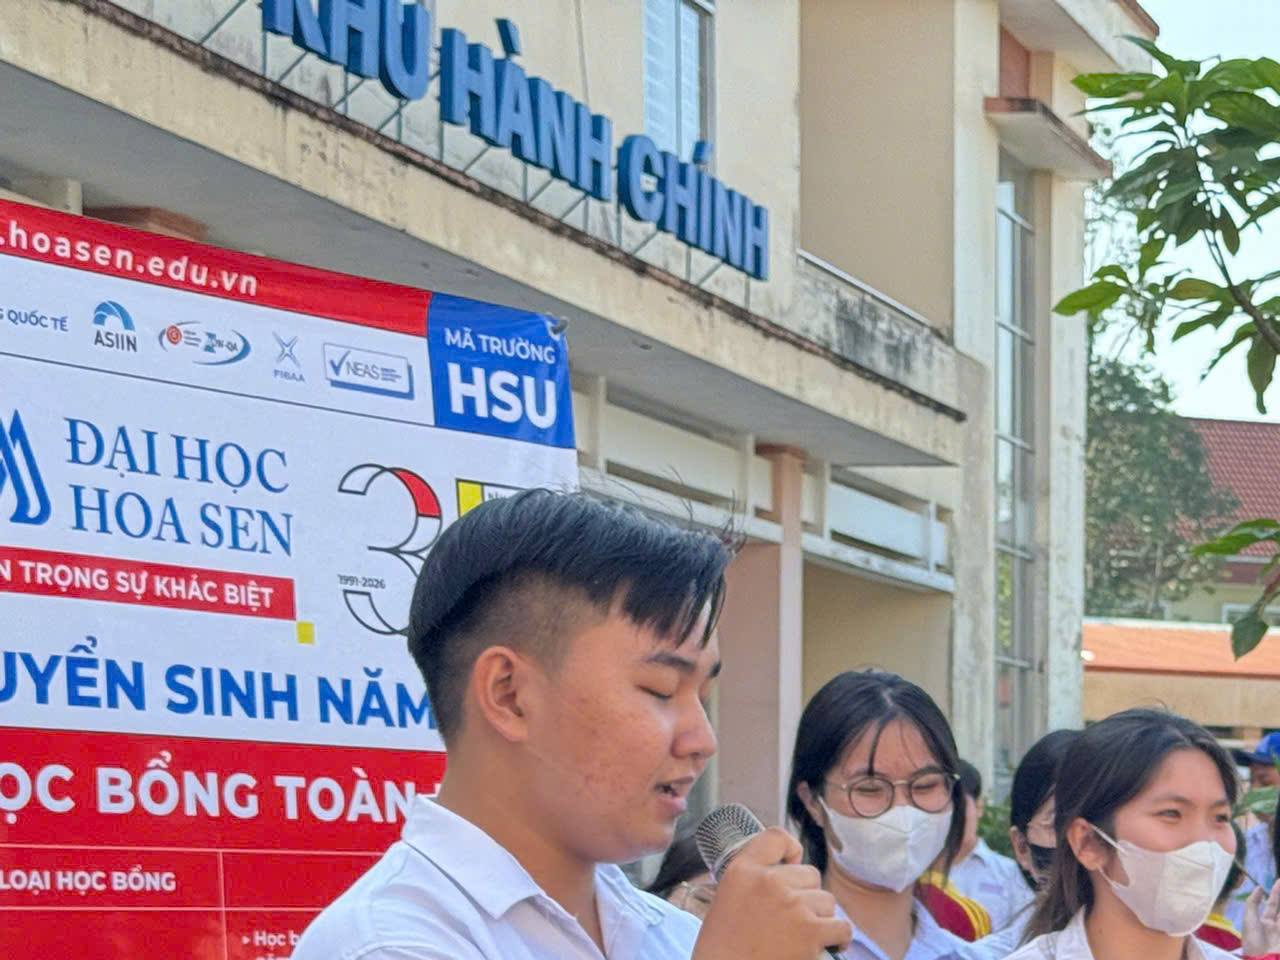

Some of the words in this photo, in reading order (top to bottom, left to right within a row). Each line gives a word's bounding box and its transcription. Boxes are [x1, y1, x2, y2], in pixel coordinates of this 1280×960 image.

[440, 18, 612, 203] HÀNH
[617, 133, 769, 282] CHÍNH
[8, 307, 49, 328] QUỐC
[51, 316, 69, 332] TẾ
[94, 331, 138, 353] ASIIN
[444, 326, 476, 351] MÃ
[477, 333, 556, 364] TRƯỜNG
[447, 362, 557, 429] HSU
[64, 417, 161, 478] ĐẠI
[170, 433, 289, 494] HỌC
[68, 483, 191, 545] HOA
[199, 502, 293, 557] SEN
[18, 560, 109, 592] TRỌNG
[116, 570, 148, 600] SỰ
[154, 574, 219, 603] KHÁC
[223, 580, 274, 611] BIỆT
[338, 574, 386, 589] 1991-2026
[164, 663, 299, 721] SINH
[318, 667, 437, 729] NĂM
[96, 751, 259, 819] BỔNG
[274, 767, 415, 824] TOÀN
[0, 870, 51, 896] LOẠI
[56, 871, 106, 896] HỌC
[111, 863, 177, 892] BỔNG
[254, 931, 286, 951] Học
